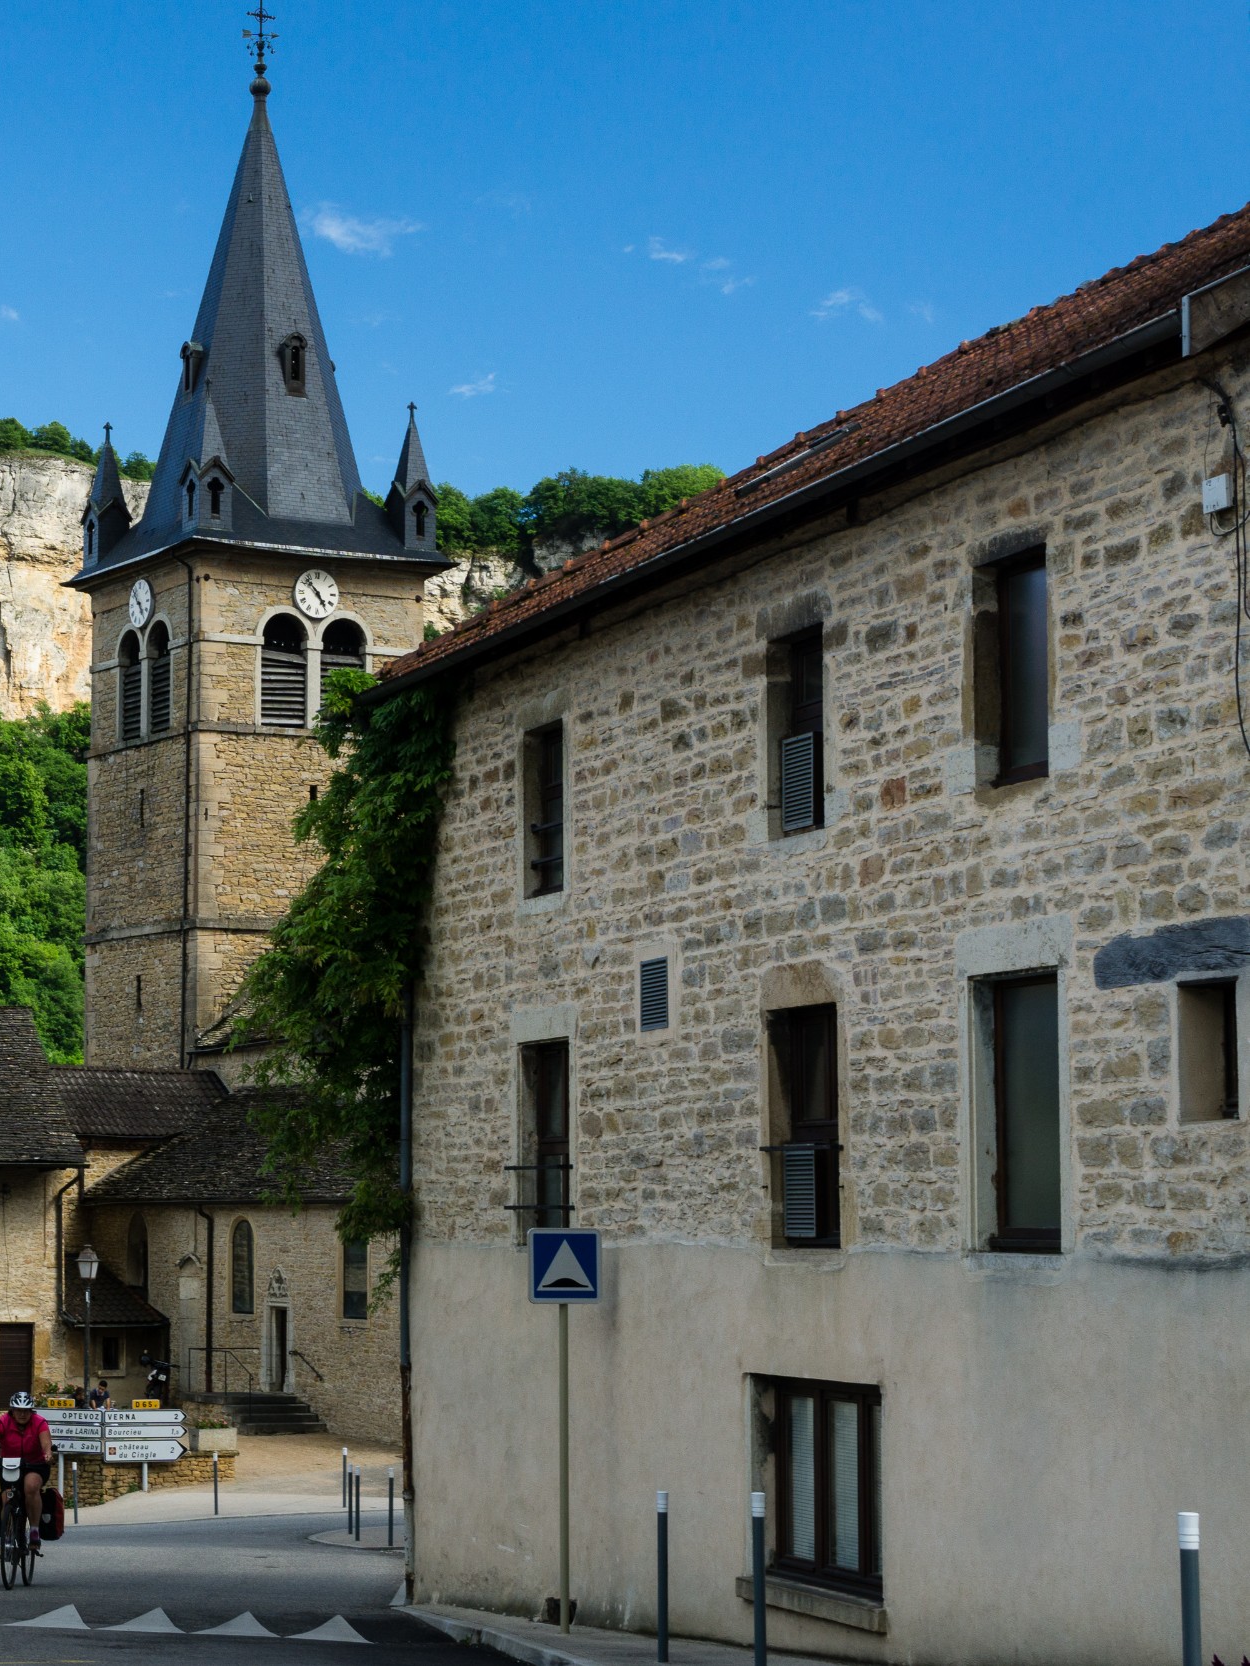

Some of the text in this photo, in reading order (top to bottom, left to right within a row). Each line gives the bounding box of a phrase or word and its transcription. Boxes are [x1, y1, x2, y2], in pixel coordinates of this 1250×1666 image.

[50, 1399, 55, 1407] D
[62, 1412, 99, 1420] OPTEVOZ
[107, 1413, 136, 1421] VERNA
[66, 1427, 74, 1435] de
[108, 1428, 142, 1436] Bourcieu
[81, 1443, 99, 1451] Saby
[170, 1446, 175, 1454] 2
[119, 1451, 157, 1460] du Cingle
